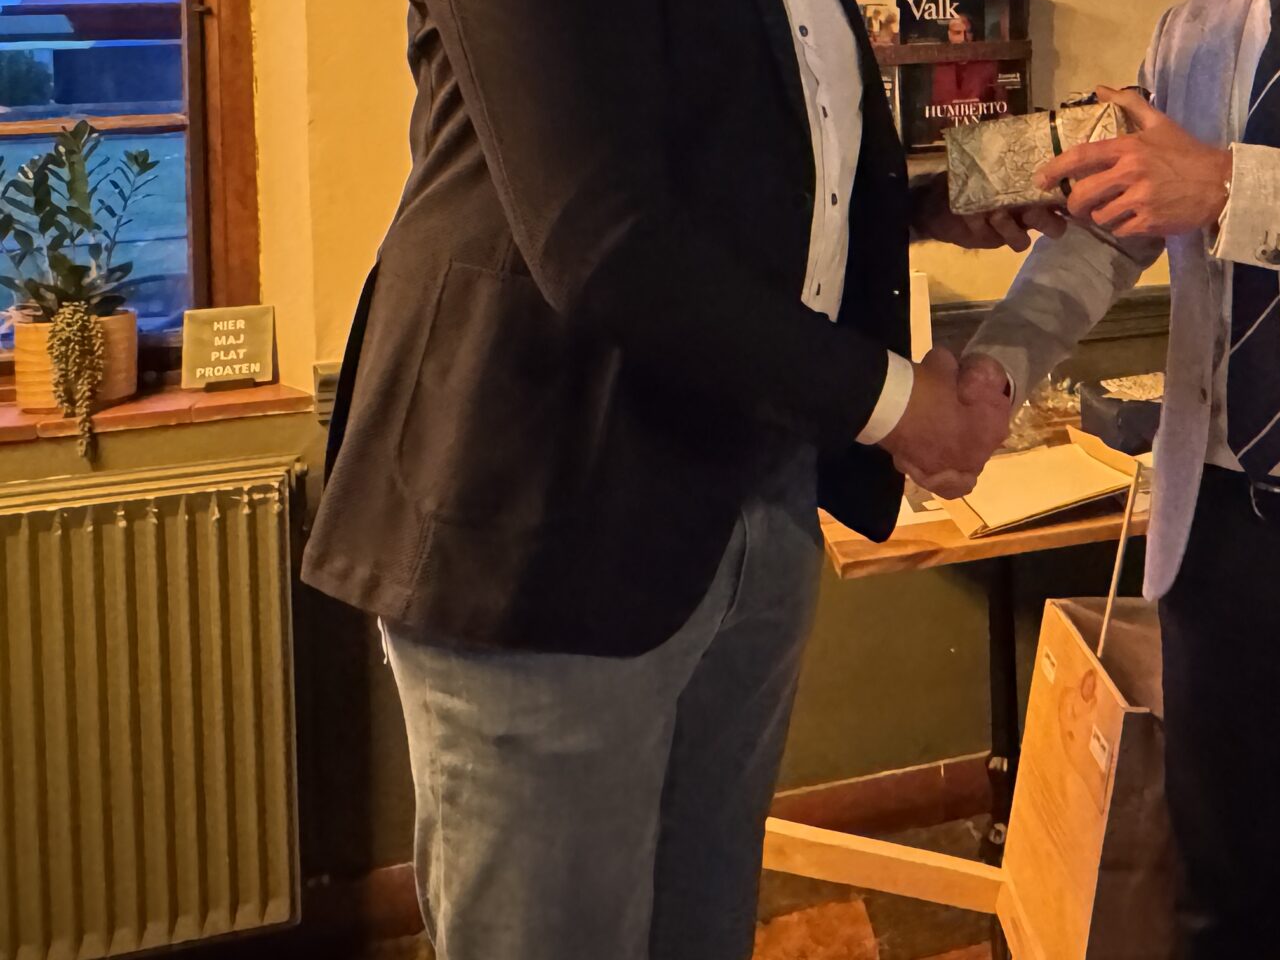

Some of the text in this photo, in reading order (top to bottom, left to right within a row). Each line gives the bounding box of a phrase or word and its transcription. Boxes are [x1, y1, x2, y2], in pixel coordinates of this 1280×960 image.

[925, 101, 1007, 118] HUMBERTO
[213, 319, 245, 331] HIER
[214, 334, 245, 346] MAJ
[211, 348, 248, 361] PLAT
[196, 362, 260, 378] PROATEN
